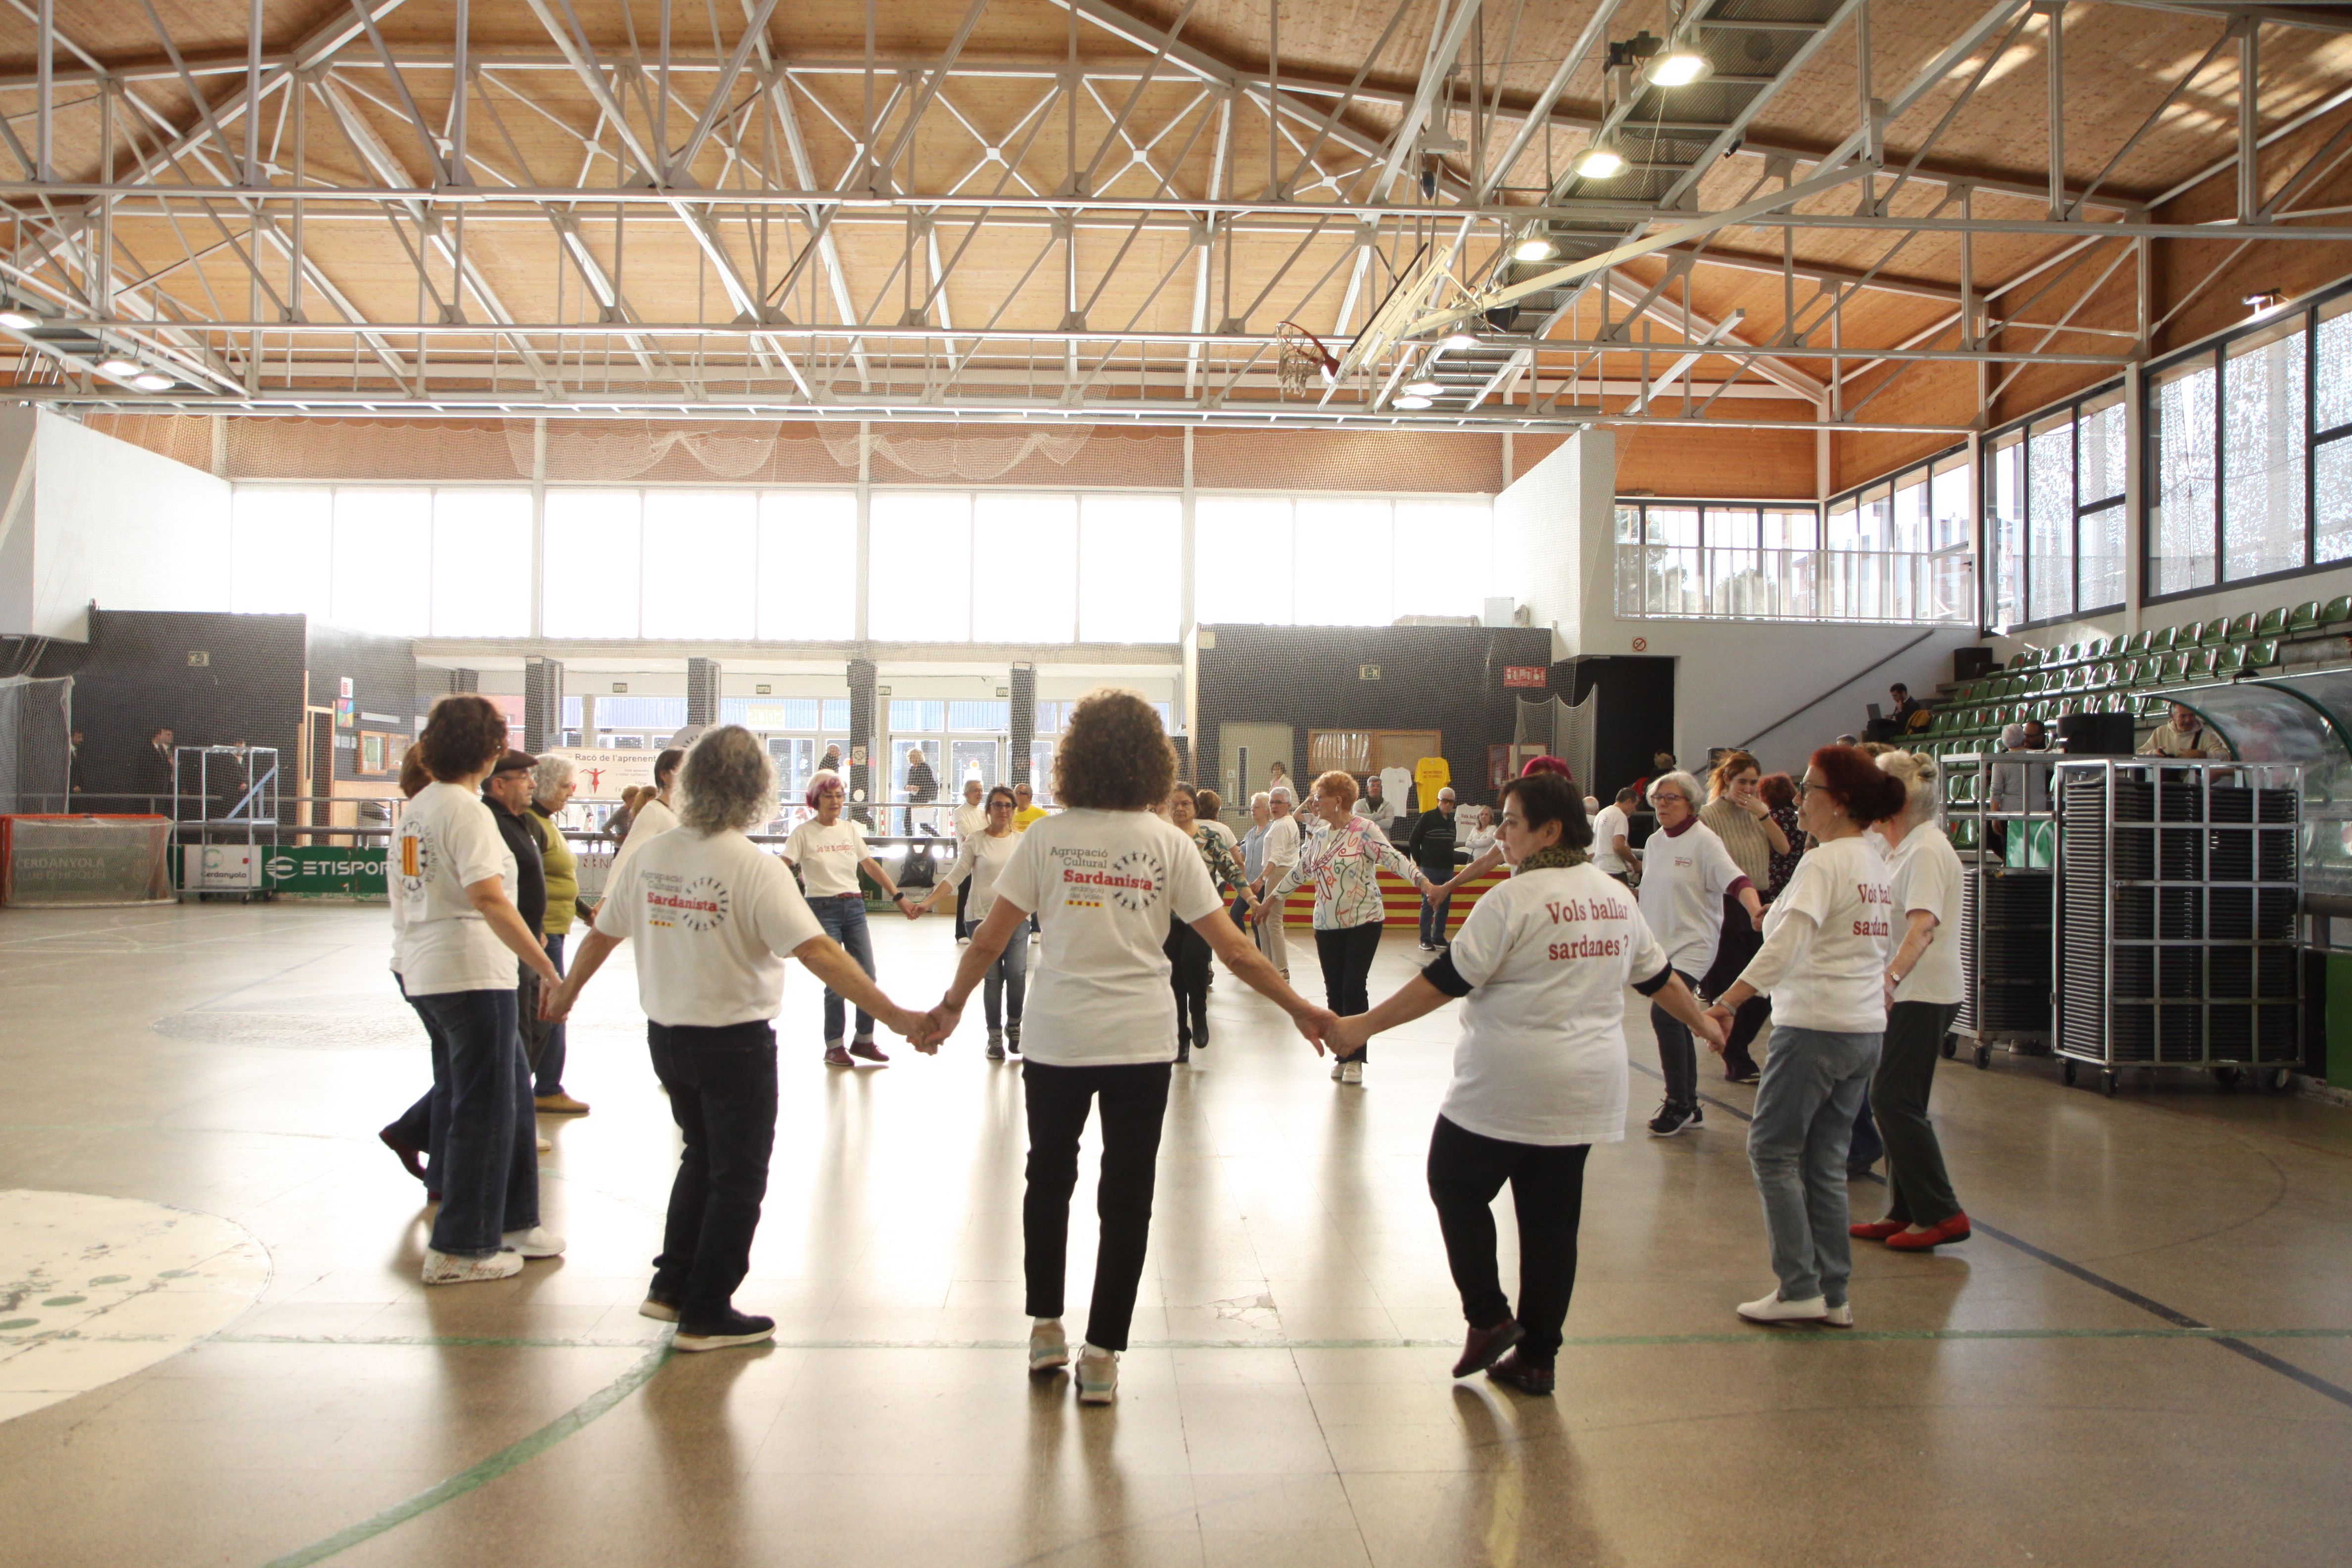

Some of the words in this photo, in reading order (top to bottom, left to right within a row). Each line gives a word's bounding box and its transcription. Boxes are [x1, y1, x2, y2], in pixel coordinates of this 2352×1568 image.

[575, 753, 597, 762] Racó
[1050, 846, 1108, 858] Agrupació
[1063, 857, 1107, 869] Cultural
[1064, 869, 1153, 891] Sardanista
[647, 891, 718, 912] Sardanista
[1857, 883, 1877, 904] Vos
[1545, 898, 1586, 925] Vols
[1588, 897, 1628, 921] ballar
[1548, 934, 1620, 961] sardanes
